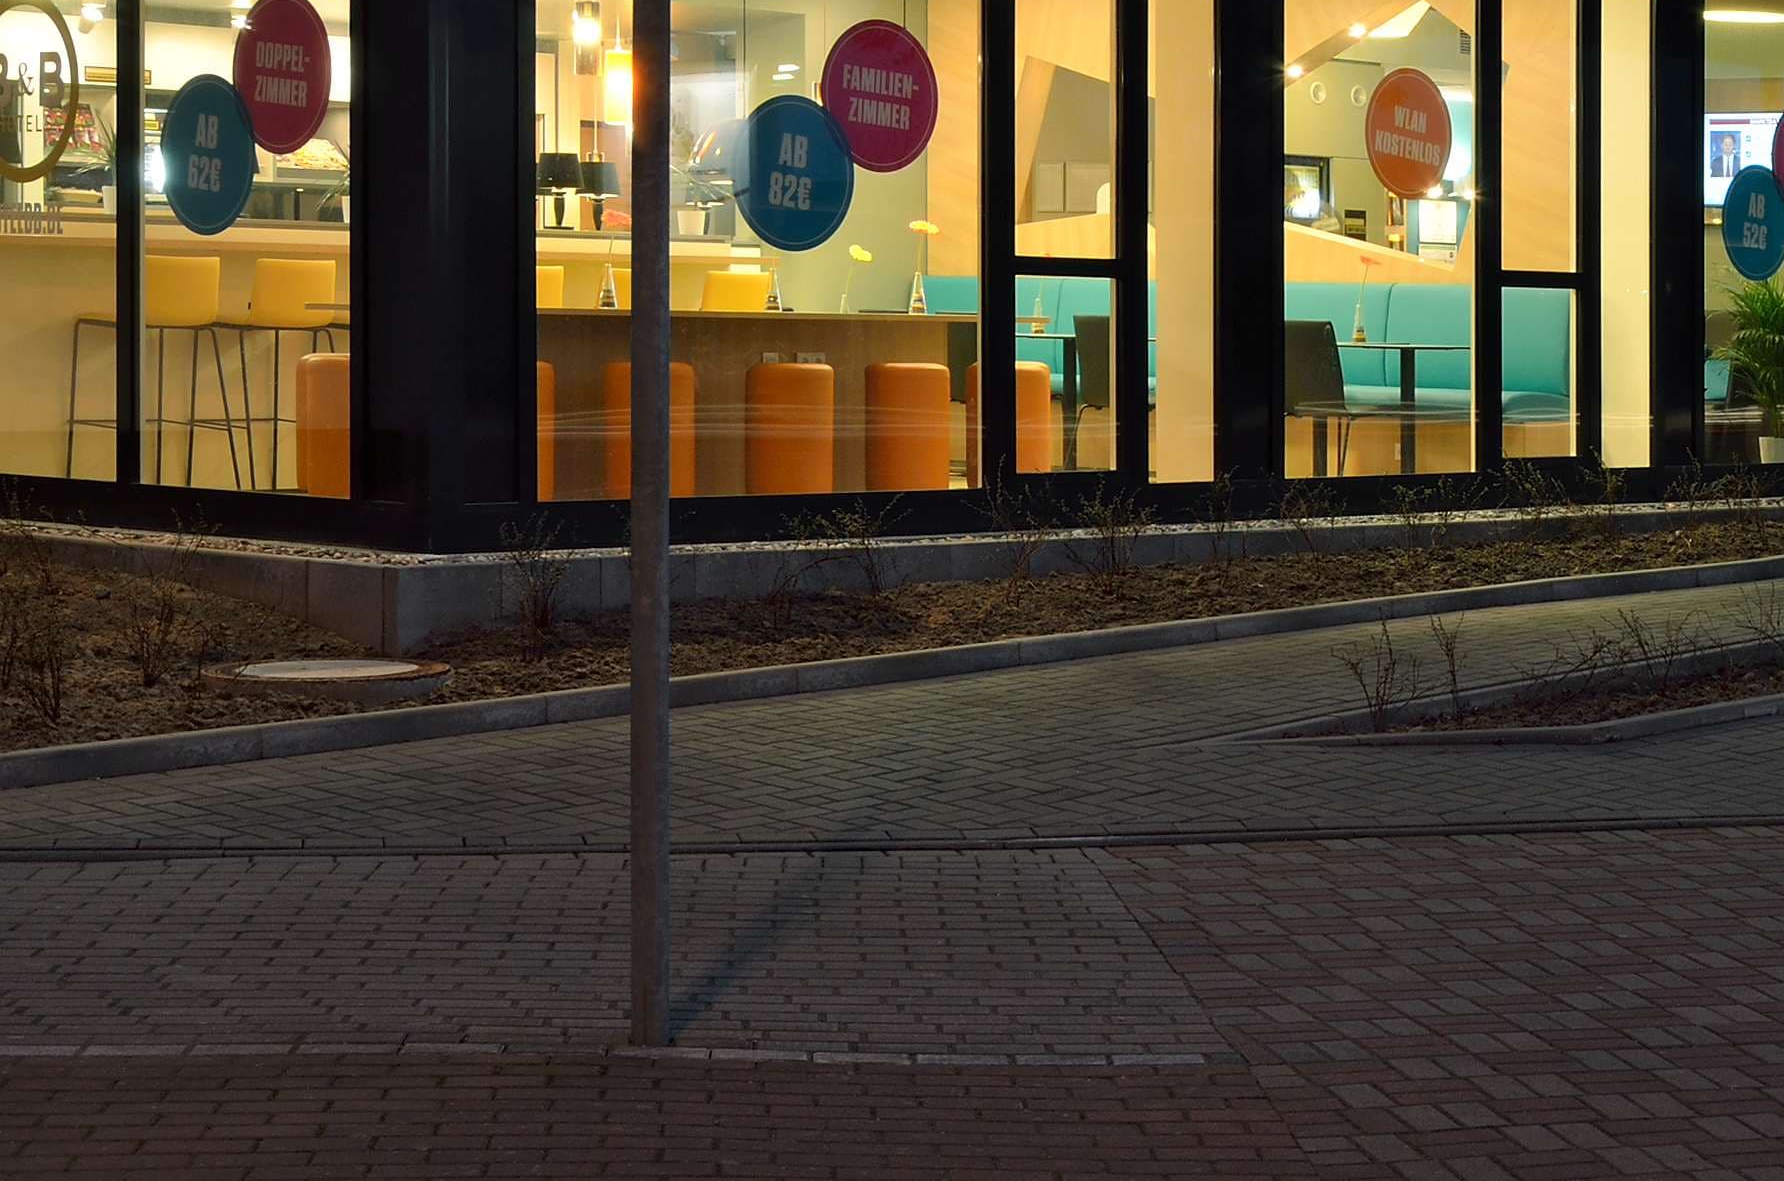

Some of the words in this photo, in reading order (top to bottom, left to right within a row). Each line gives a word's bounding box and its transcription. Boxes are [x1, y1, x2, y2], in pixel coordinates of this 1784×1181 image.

[255, 41, 311, 73] DOPPEL-
[254, 75, 308, 108] ZIMMER
[842, 63, 920, 100] FAMILIEN-
[195, 113, 219, 149] AB
[847, 96, 911, 131] ZIMMER
[1394, 104, 1428, 134] WLAN
[778, 132, 809, 169] AB
[1375, 129, 1441, 167] KOSTENLOS
[187, 154, 222, 193] 62€
[767, 171, 812, 211] 82€
[1747, 192, 1766, 219] AB
[1742, 221, 1769, 250] 52€
